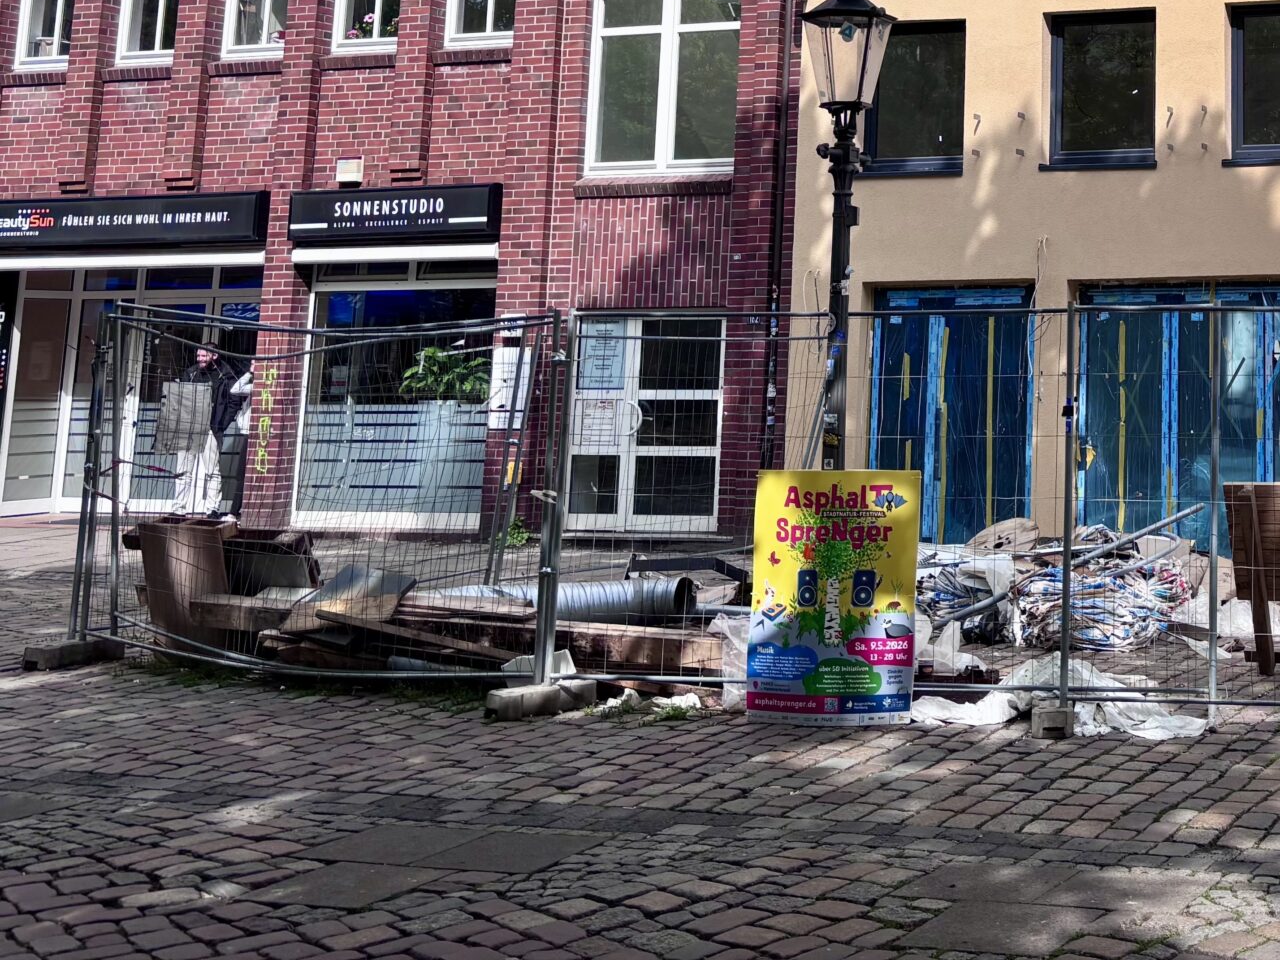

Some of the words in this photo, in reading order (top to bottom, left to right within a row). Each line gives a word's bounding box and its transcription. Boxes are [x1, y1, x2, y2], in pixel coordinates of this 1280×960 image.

[334, 197, 444, 217] SONNENSTUDIO
[62, 214, 94, 227] FÜHLEN
[97, 215, 110, 226] SIE
[112, 214, 132, 226] SICH
[135, 213, 159, 225] WOHL
[162, 213, 172, 224] IN
[175, 212, 202, 223] IHRER
[204, 211, 231, 223] HAUT.
[365, 219, 408, 227] EXCELLENCE
[418, 217, 444, 225] ESPRIT
[784, 483, 893, 515] AsphalT
[776, 517, 893, 550] SpreNger
[756, 646, 775, 654] Musik
[854, 642, 868, 650] Sa.
[870, 640, 908, 651] 9.5.2026
[883, 653, 894, 661] 20
[754, 697, 817, 709] asphaltsprenger.de
